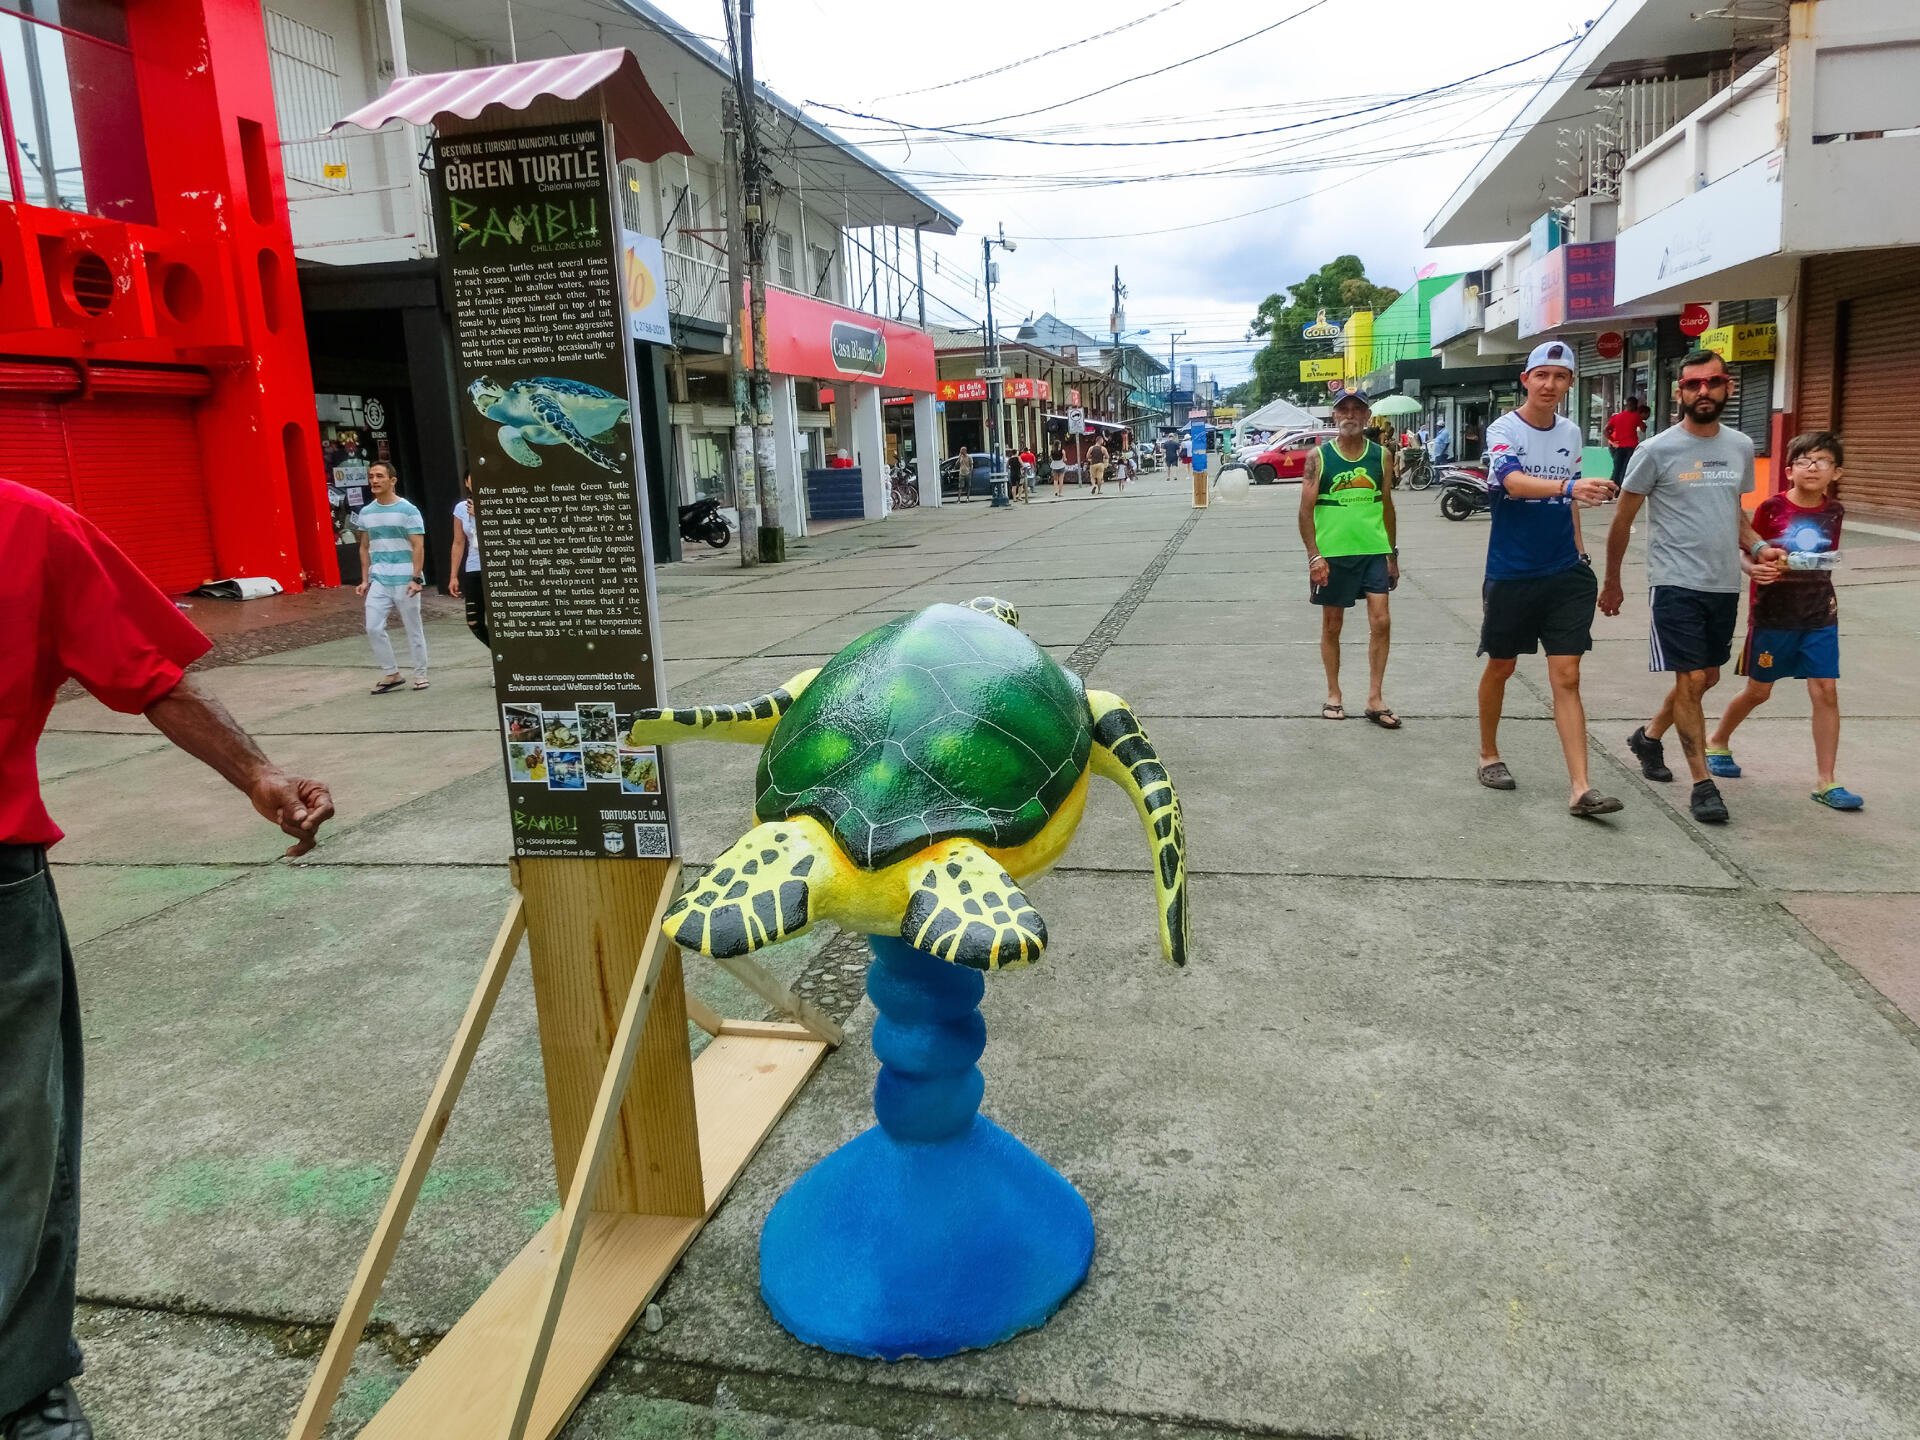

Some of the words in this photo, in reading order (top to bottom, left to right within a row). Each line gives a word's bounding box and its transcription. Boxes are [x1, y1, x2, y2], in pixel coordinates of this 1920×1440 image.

[441, 144, 472, 158] GESTIÓN
[473, 144, 482, 154] DE
[484, 138, 517, 154] TURISMO
[518, 136, 558, 150] MUNICIPAL
[560, 134, 570, 145] DE
[572, 130, 595, 144] LIMÓN
[445, 159, 514, 191] GREEN
[518, 150, 600, 184] TURTLE
[538, 183, 572, 192] Chelonia
[574, 179, 600, 190] mydas
[531, 244, 552, 253] CHILL
[555, 241, 577, 251] ZONE
[585, 239, 602, 248] BAR
[453, 266, 479, 276] Female
[508, 263, 534, 271] Turtles
[557, 259, 583, 268] several
[456, 298, 470, 306] and
[474, 296, 502, 305] females
[506, 293, 540, 304] approach
[544, 292, 561, 300] each
[457, 308, 475, 316] male
[478, 306, 499, 315] turtle
[502, 305, 525, 315] places
[528, 302, 555, 311] himself
[571, 301, 584, 310] top
[460, 328, 477, 337] until
[490, 326, 521, 335] achieves
[575, 320, 613, 331] aggressive
[1680, 318, 1704, 326] Claro
[461, 339, 478, 347] male
[481, 337, 505, 346] turtles
[542, 335, 553, 343] try
[565, 332, 583, 340] evict
[586, 330, 614, 339] another
[1306, 328, 1338, 337] GOLLO
[462, 349, 482, 357] turtle
[507, 346, 518, 354] his
[557, 341, 601, 353] occasionally
[833, 338, 850, 358] Casa
[557, 352, 581, 361] female
[551, 483, 574, 491] female
[492, 549, 510, 557] deep
[571, 545, 602, 554] carefully
[605, 544, 634, 553] deposits
[548, 567, 570, 576] finally
[540, 577, 594, 585] development
[490, 589, 537, 597] determination
[598, 586, 624, 595] depend
[544, 674, 575, 682] company
[576, 672, 613, 681] committed
[567, 683, 593, 691] Welfare
[600, 810, 637, 820] TORTUGAS
[638, 810, 648, 820] DE
[648, 810, 666, 820] VIDA
